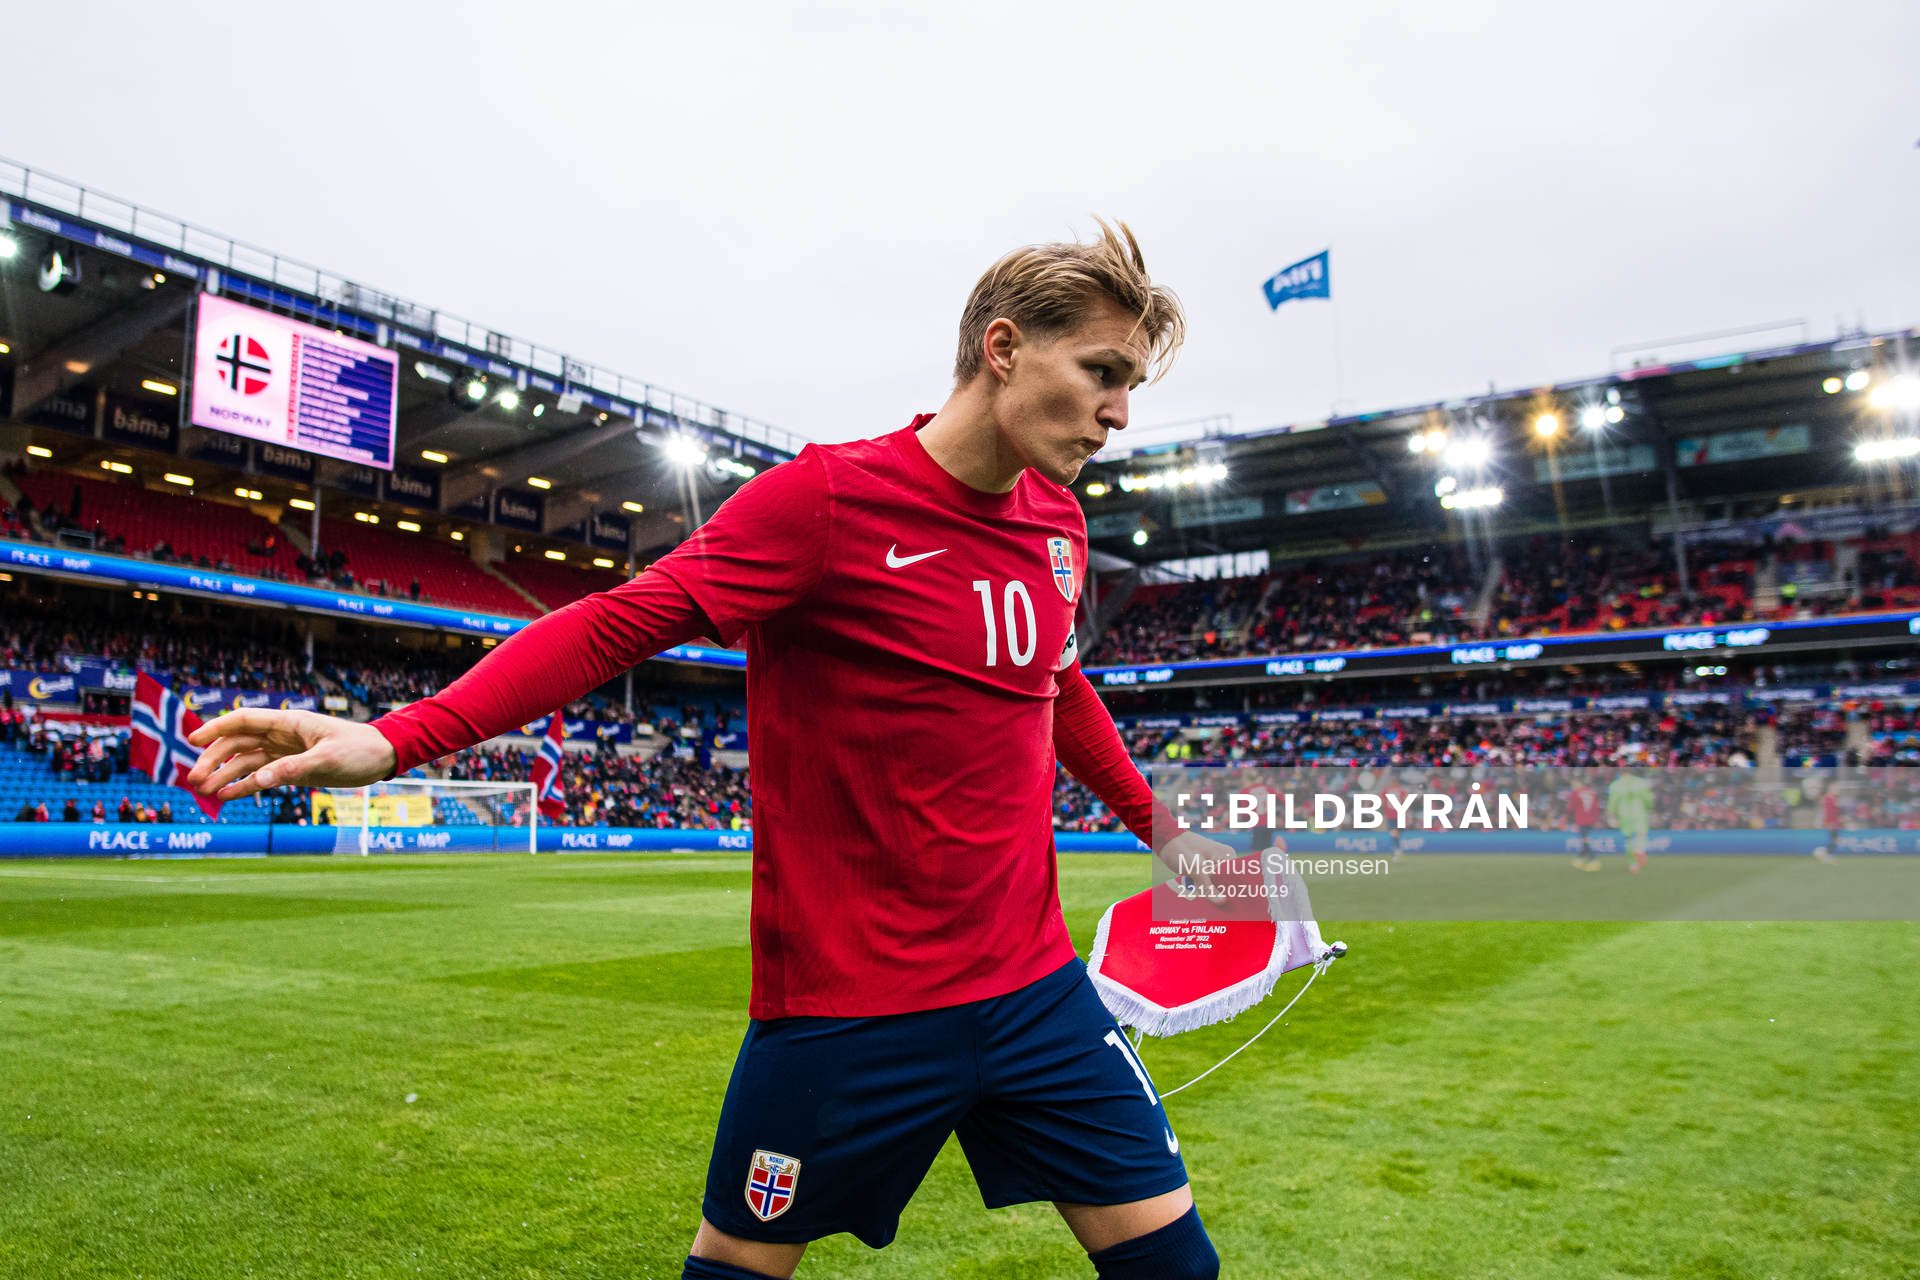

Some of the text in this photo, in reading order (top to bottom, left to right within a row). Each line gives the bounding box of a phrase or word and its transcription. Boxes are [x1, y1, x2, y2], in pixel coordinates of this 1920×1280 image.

[113, 405, 171, 440] bama
[210, 405, 272, 429] NORWAY
[972, 579, 1037, 667] 10
[89, 830, 150, 850] PEACE
[562, 833, 598, 848] PEACE
[1149, 926, 1181, 935] NORWAY
[1191, 925, 1227, 934] FINLAND
